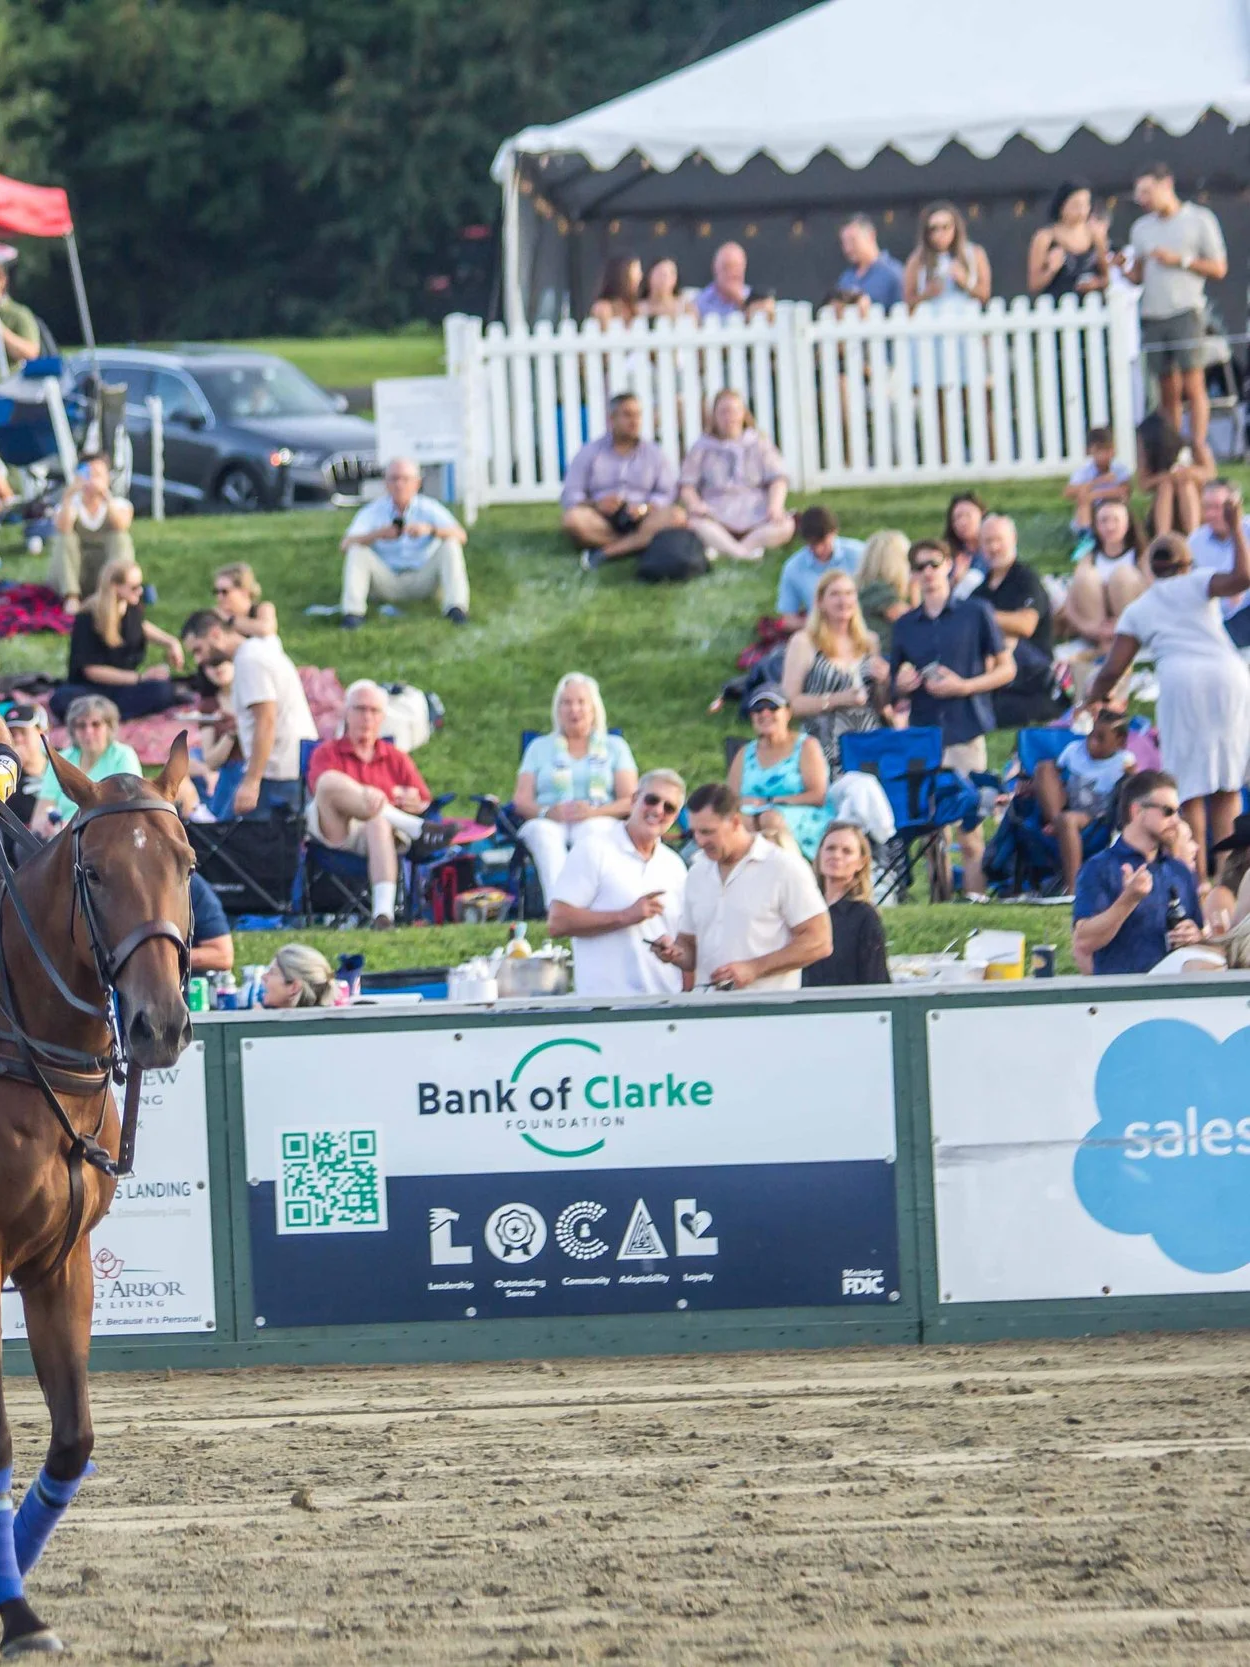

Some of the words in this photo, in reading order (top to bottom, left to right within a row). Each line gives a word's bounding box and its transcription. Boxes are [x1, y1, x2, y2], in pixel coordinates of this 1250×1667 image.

[418, 1079, 517, 1115] Bank
[529, 1076, 572, 1112] of
[584, 1073, 714, 1110] Clarke
[505, 1115, 626, 1131] FOUNDATION
[1123, 1106, 1250, 1160] sales
[128, 1181, 191, 1199] LANDING
[493, 1278, 547, 1289] Outstanding
[561, 1275, 611, 1287] Community
[618, 1272, 671, 1285] Adaptability
[682, 1271, 714, 1284] Loyalty
[110, 1280, 187, 1298] ARBOR
[428, 1280, 475, 1291] Leadership
[841, 1276, 885, 1295] FDIC
[505, 1289, 537, 1299] Service
[110, 1300, 165, 1309] LIVING
[106, 1317, 143, 1326] Because
